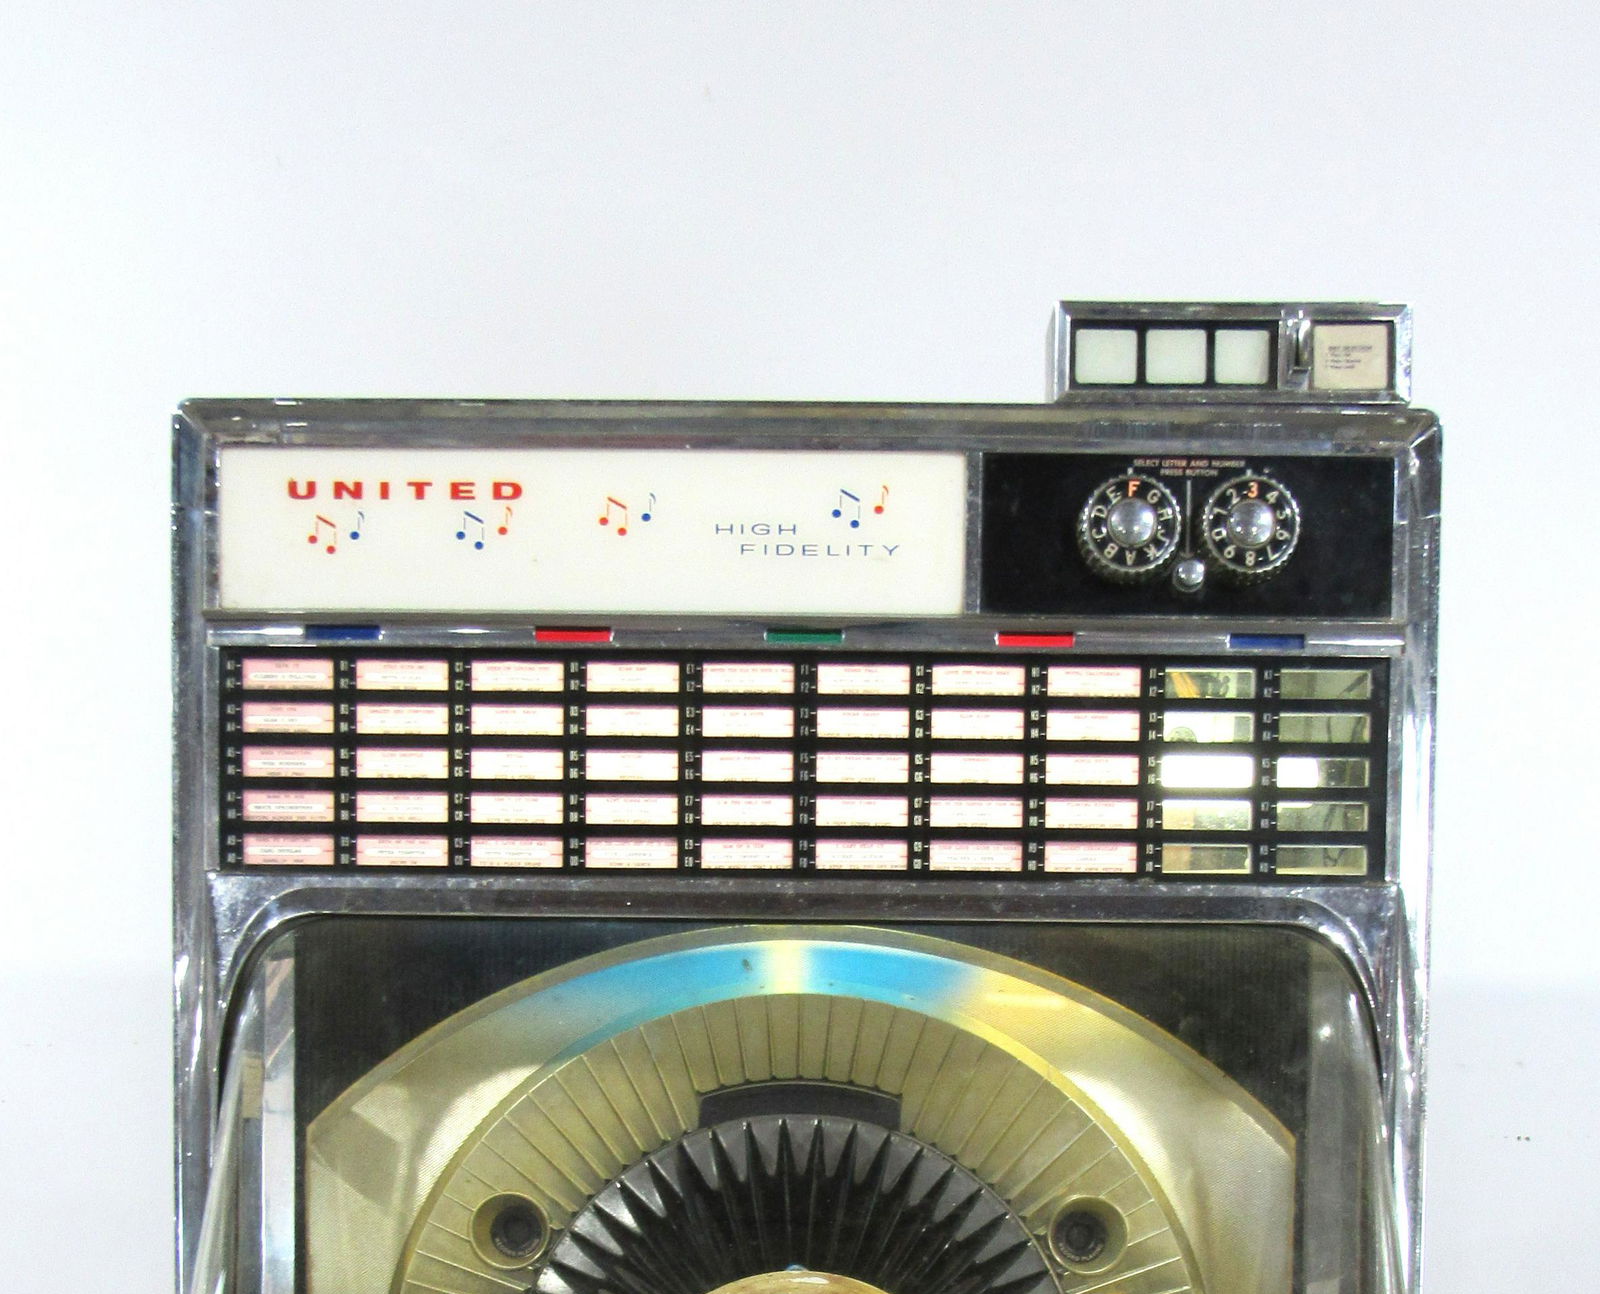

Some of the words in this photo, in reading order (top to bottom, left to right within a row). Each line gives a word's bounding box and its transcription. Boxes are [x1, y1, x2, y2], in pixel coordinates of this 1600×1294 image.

[1133, 459, 1160, 467] SELECT
[1161, 459, 1188, 467] LETTER
[1189, 459, 1210, 467] AND
[1211, 459, 1246, 468] NUMBER
[1160, 468, 1184, 476] PRESS
[1185, 468, 1219, 476] BUTTON
[287, 478, 524, 500] UNITED
[1106, 486, 1122, 504] E
[1128, 481, 1141, 497] F
[1247, 482, 1259, 498] 3
[1147, 489, 1162, 504] G
[1226, 488, 1241, 505] 2
[1266, 491, 1281, 504] 4
[1091, 505, 1108, 519] D
[1157, 507, 1174, 521] H
[715, 523, 796, 536] HIGH
[1092, 527, 1107, 540] C
[740, 543, 899, 556] FIDELITY
[1104, 543, 1119, 559] B
[1143, 544, 1161, 561] K
[1125, 549, 1137, 566] A
[1245, 550, 1256, 566] 8
[687, 663, 695, 674] E1
[687, 680, 695, 691] E2
[686, 706, 695, 717] E3
[686, 723, 695, 735] E4
[685, 751, 694, 762] E5
[685, 768, 694, 779] E6
[685, 795, 694, 806] E7
[685, 812, 694, 823] E8
[685, 838, 694, 849] E9
[685, 856, 694, 867] E0
